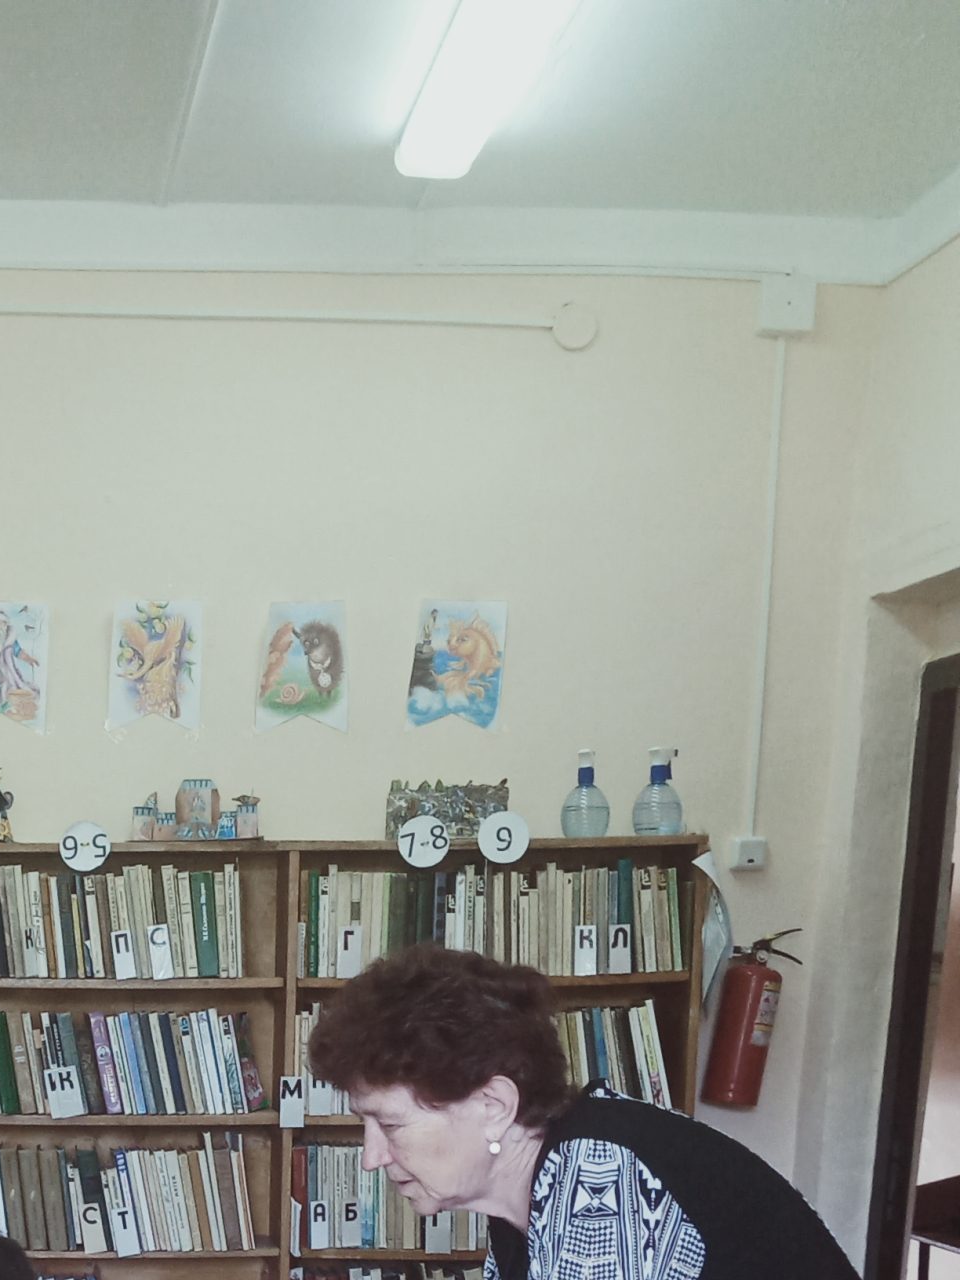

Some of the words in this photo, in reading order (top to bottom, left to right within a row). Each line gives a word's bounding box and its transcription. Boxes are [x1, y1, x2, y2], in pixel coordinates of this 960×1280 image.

[496, 827, 512, 852] 9
[114, 933, 130, 954] П
[150, 927, 166, 946] С
[344, 930, 354, 951] Г
[579, 926, 593, 949] К
[611, 926, 628, 948] Л
[59, 1071, 74, 1090] К
[281, 1079, 302, 1099] М
[82, 1206, 98, 1224] С
[117, 1210, 128, 1230] Т
[313, 1203, 326, 1222] А
[345, 1203, 358, 1222] Б
